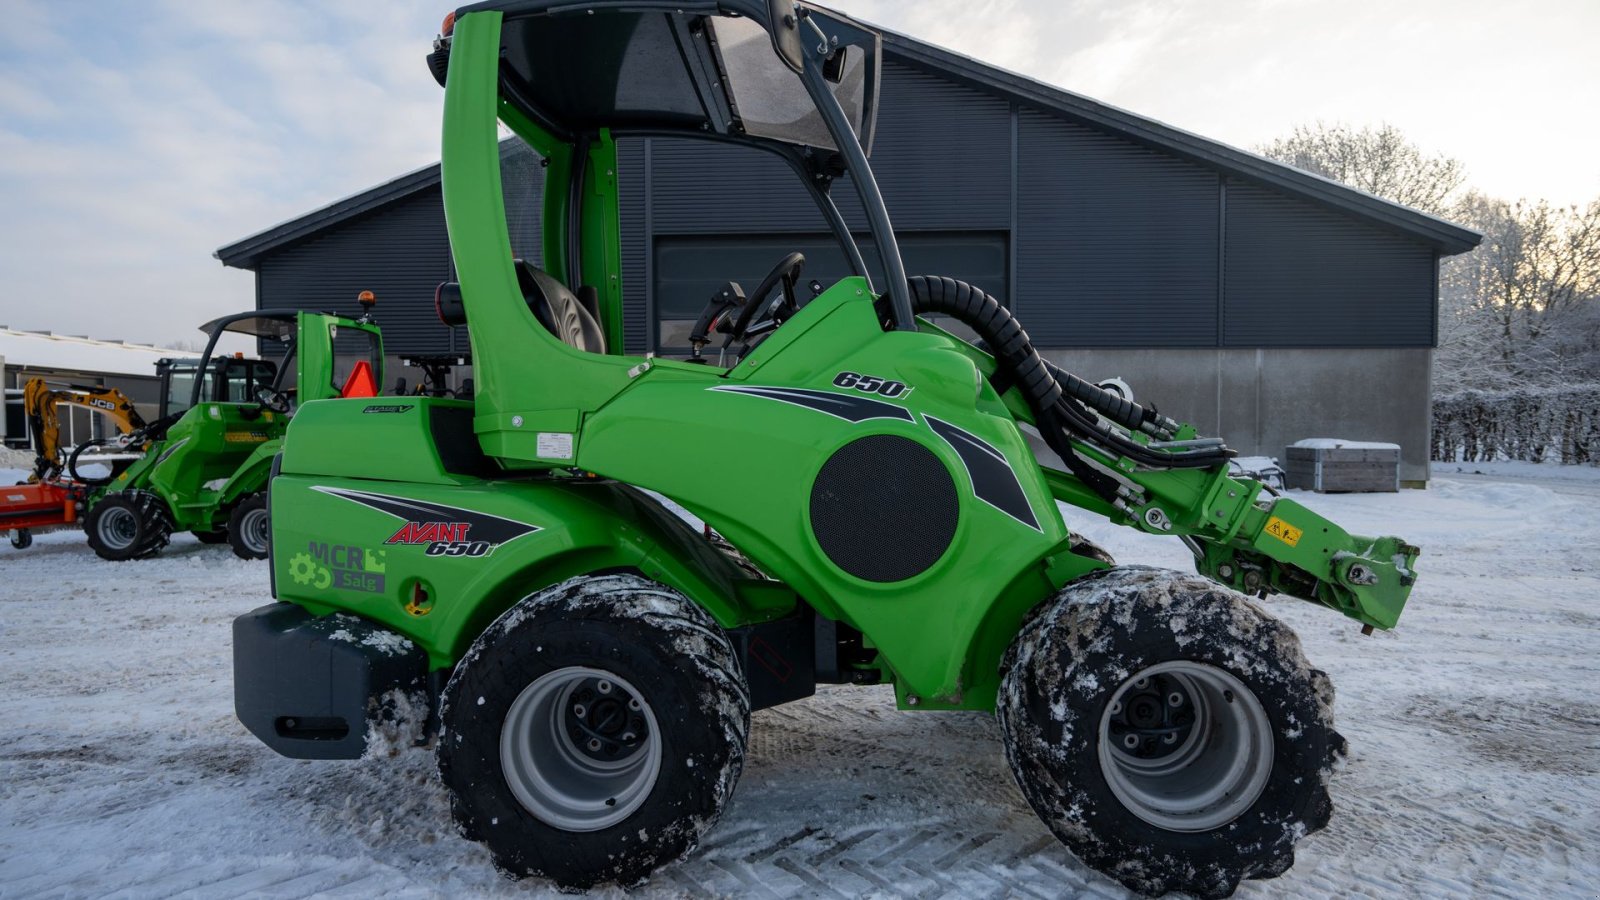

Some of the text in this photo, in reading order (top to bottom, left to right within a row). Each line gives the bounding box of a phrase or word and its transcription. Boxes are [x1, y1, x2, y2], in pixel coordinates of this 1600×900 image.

[90, 398, 115, 410] JCB
[383, 522, 471, 545] AVANT
[309, 541, 364, 571] MCR
[343, 573, 376, 592] Salg
